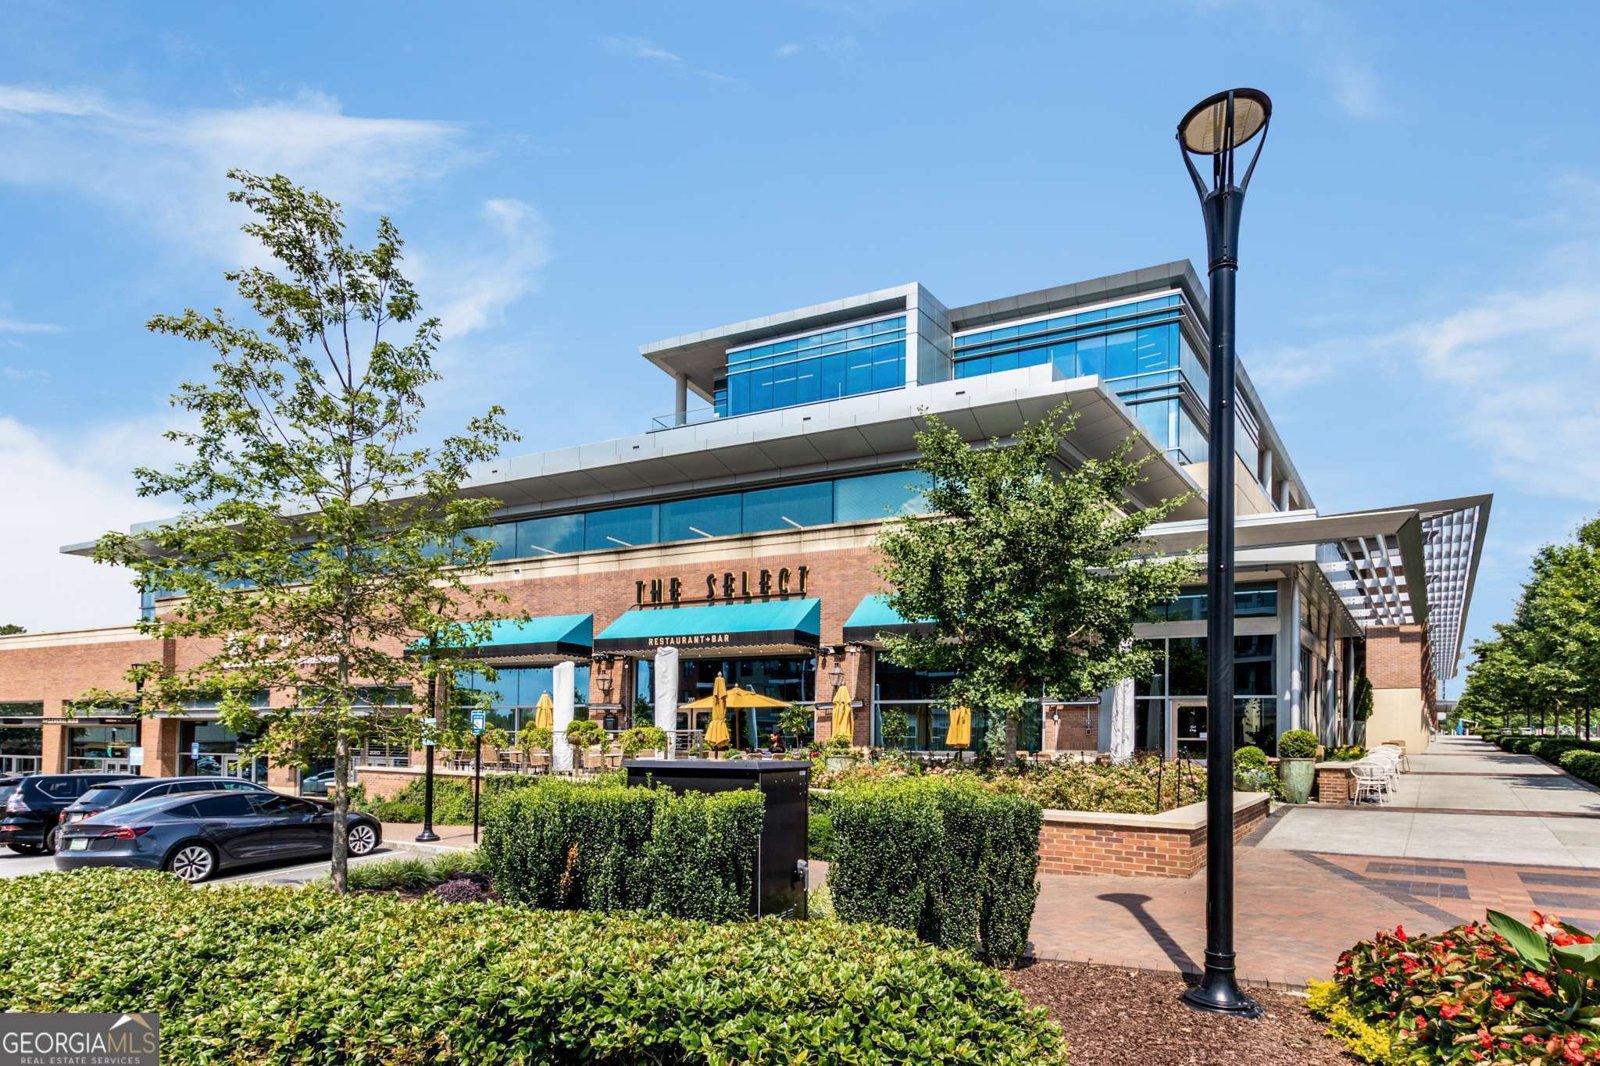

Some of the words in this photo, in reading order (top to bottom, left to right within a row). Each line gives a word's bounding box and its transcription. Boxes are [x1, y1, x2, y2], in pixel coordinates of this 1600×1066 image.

[636, 577, 682, 604] THE
[706, 566, 809, 600] SELECT
[648, 634, 730, 646] RESTAURANT+BAR
